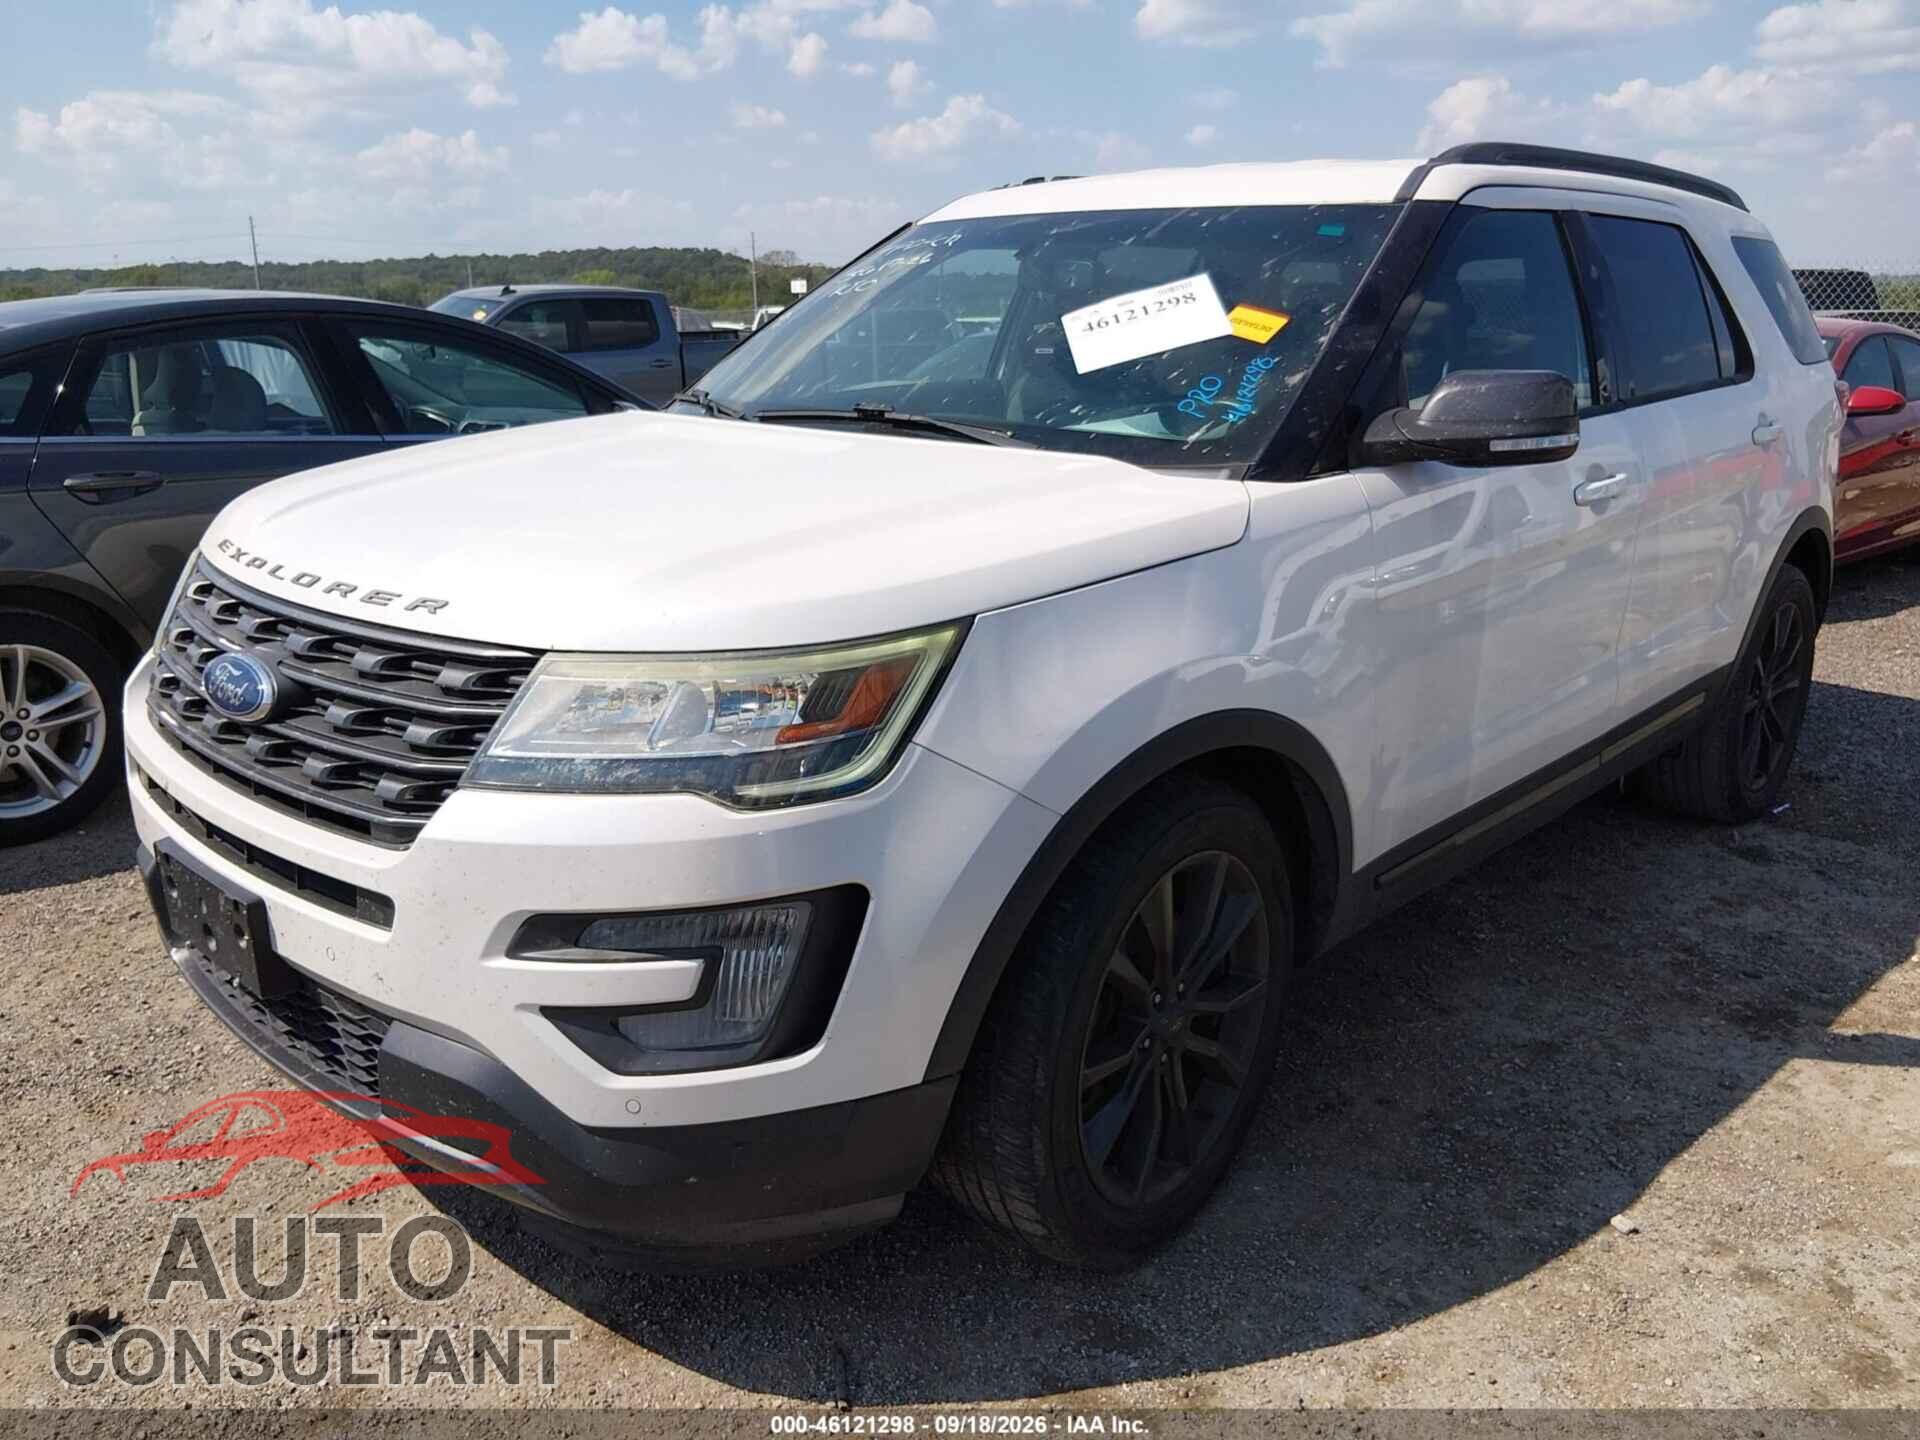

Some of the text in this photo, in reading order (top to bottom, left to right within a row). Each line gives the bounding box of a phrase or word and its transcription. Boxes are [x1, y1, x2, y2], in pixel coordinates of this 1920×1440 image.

[1081, 292, 1197, 334] 46121298
[1177, 376, 1222, 418] PRO
[216, 538, 450, 615] EXPLORER
[209, 662, 249, 705] Ford
